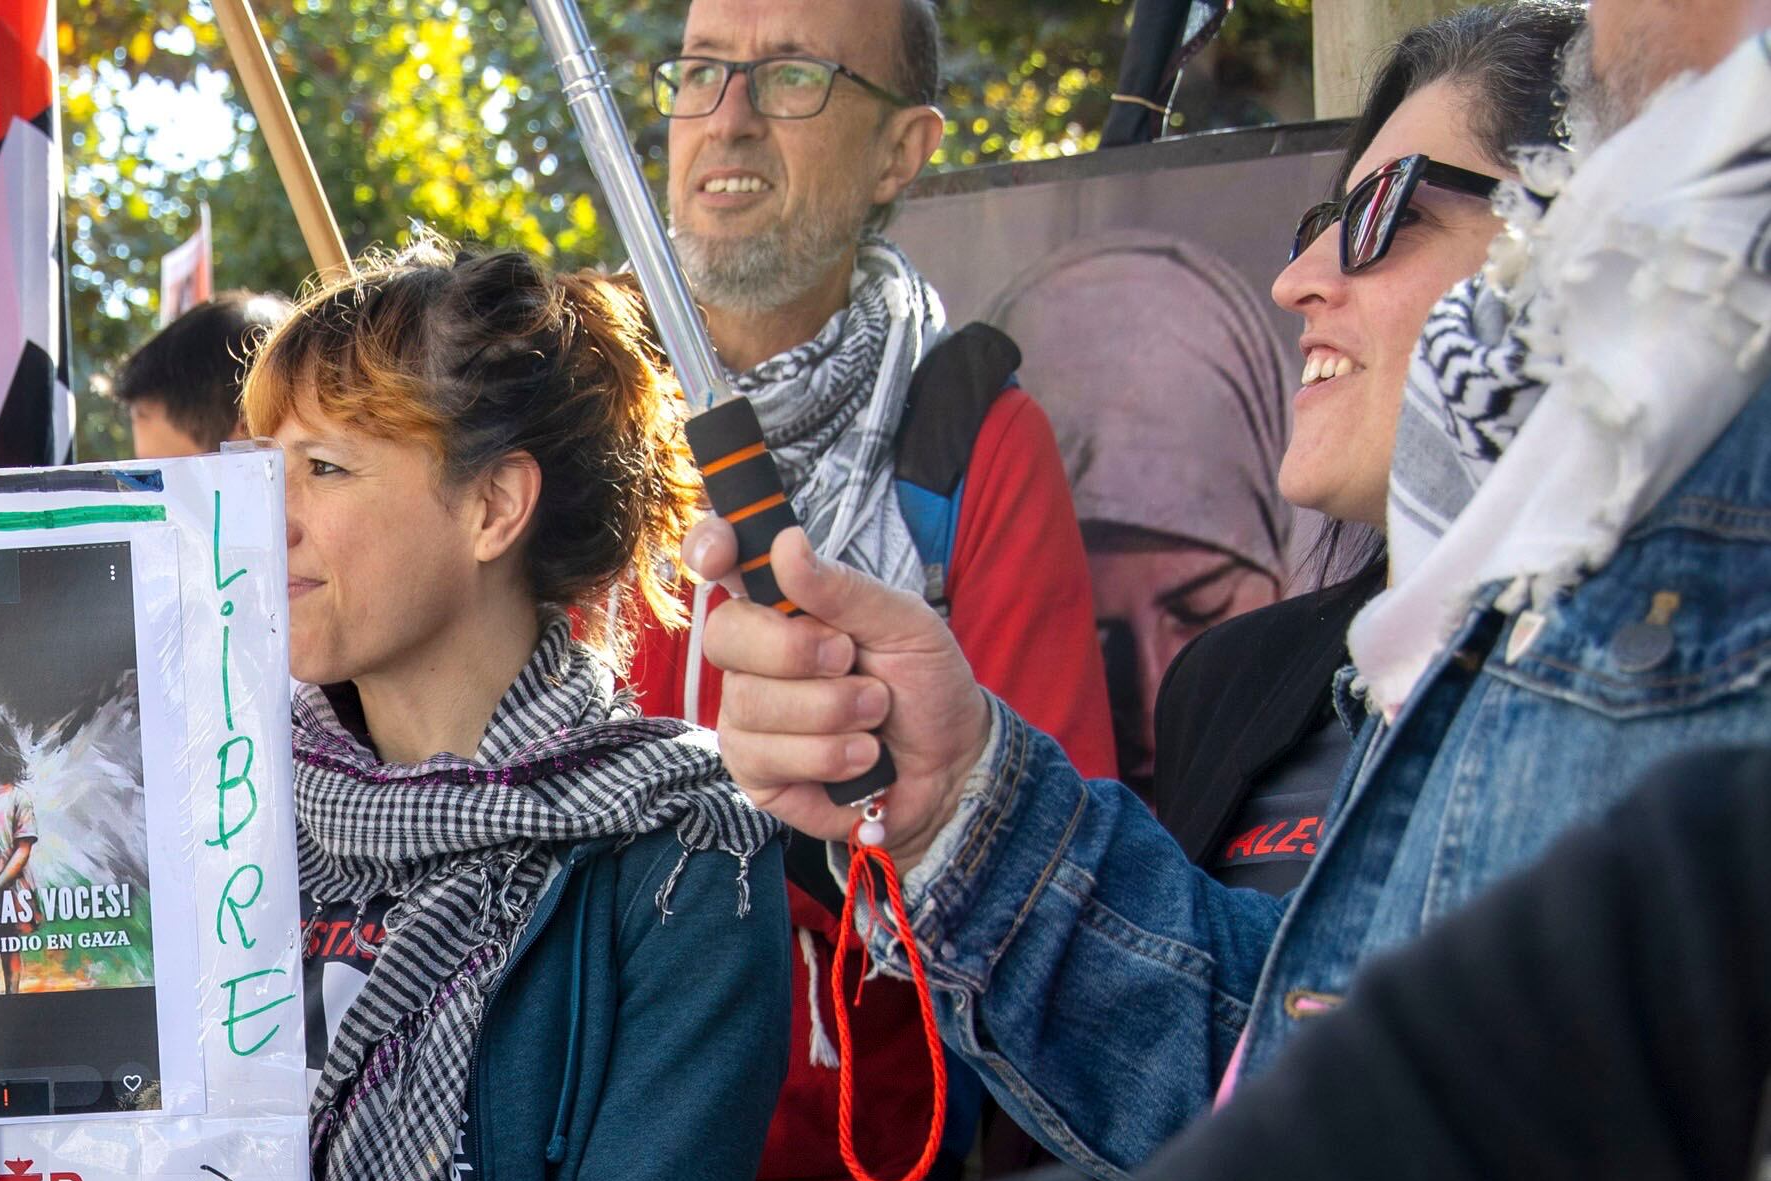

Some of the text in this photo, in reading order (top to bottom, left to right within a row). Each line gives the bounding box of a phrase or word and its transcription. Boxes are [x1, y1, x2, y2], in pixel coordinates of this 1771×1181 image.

[39, 883, 131, 921] VOCES!
[47, 933, 73, 950] EN
[77, 929, 131, 948] GAZA
